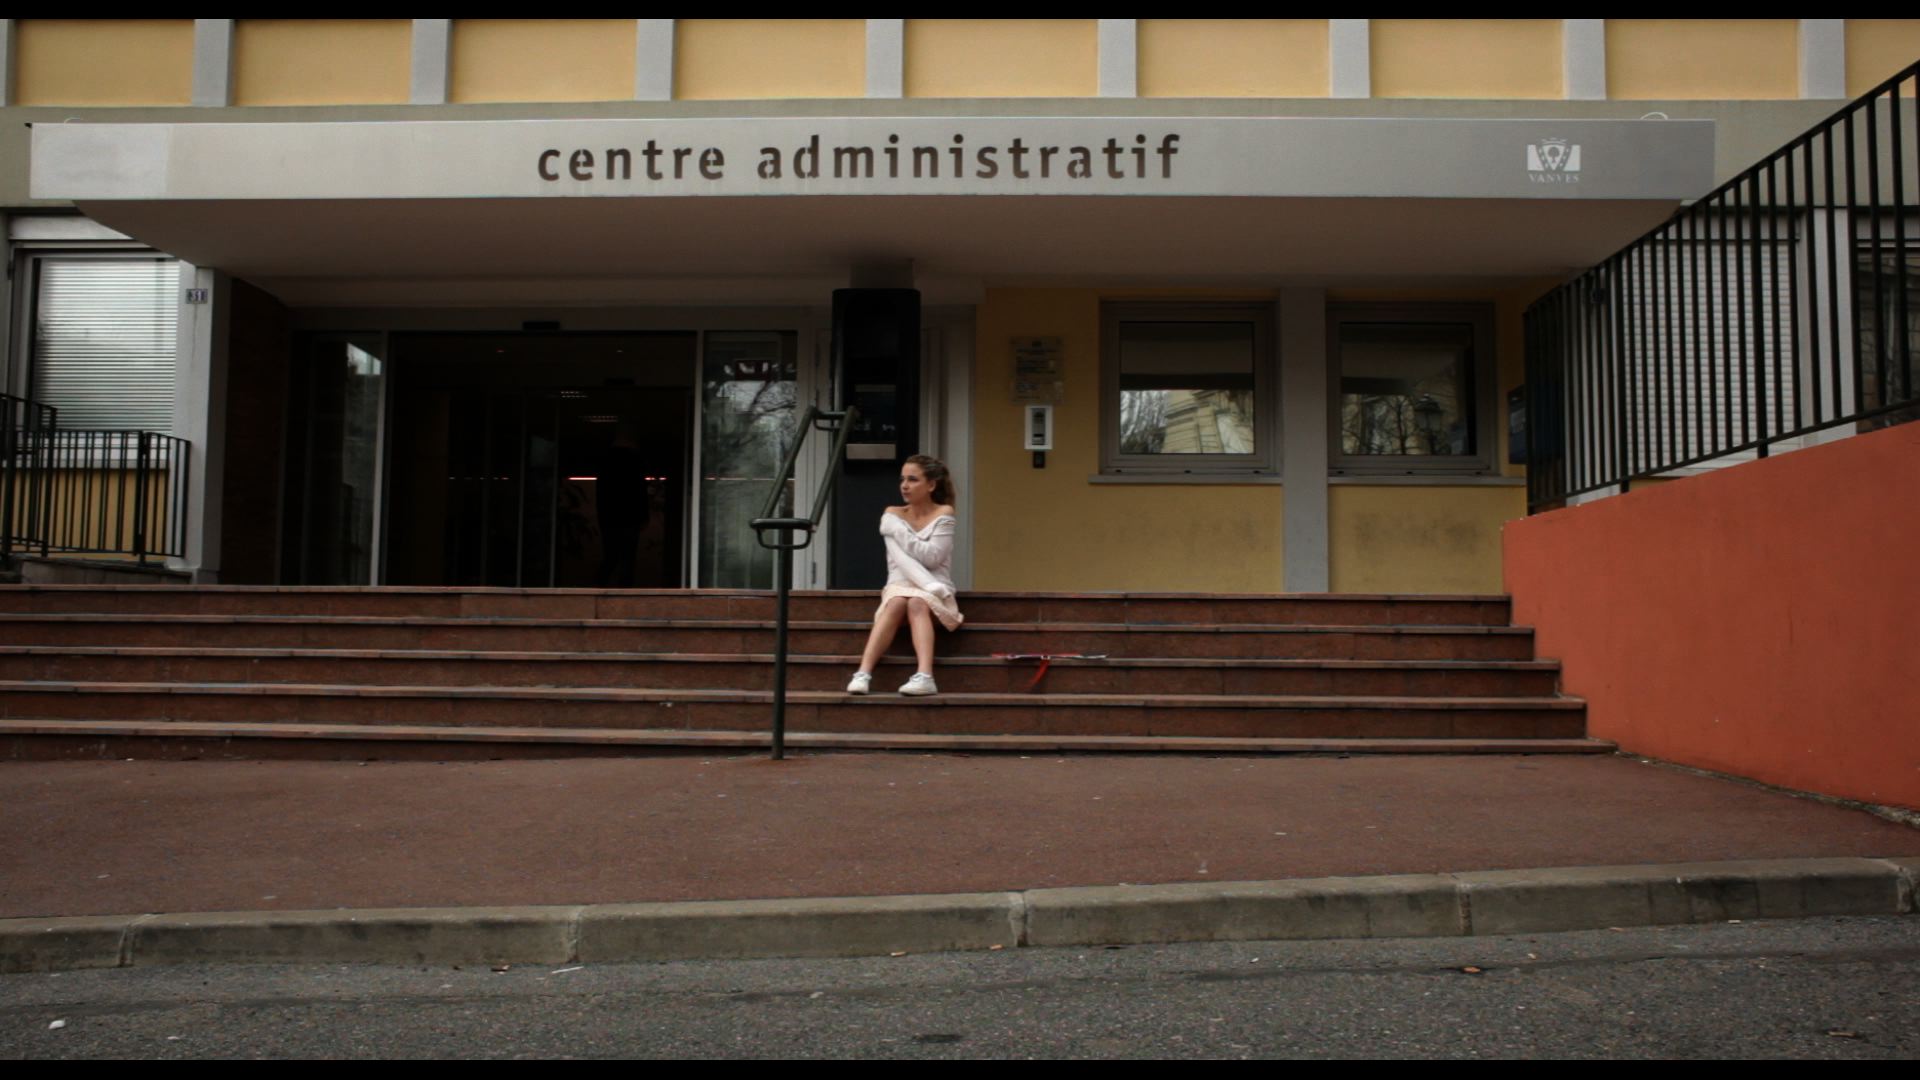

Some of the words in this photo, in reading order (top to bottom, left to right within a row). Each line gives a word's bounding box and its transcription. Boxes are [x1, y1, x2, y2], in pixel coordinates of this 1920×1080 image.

[538, 140, 725, 182] centre
[756, 133, 1181, 179] administratif
[1528, 173, 1579, 183] VANVES
